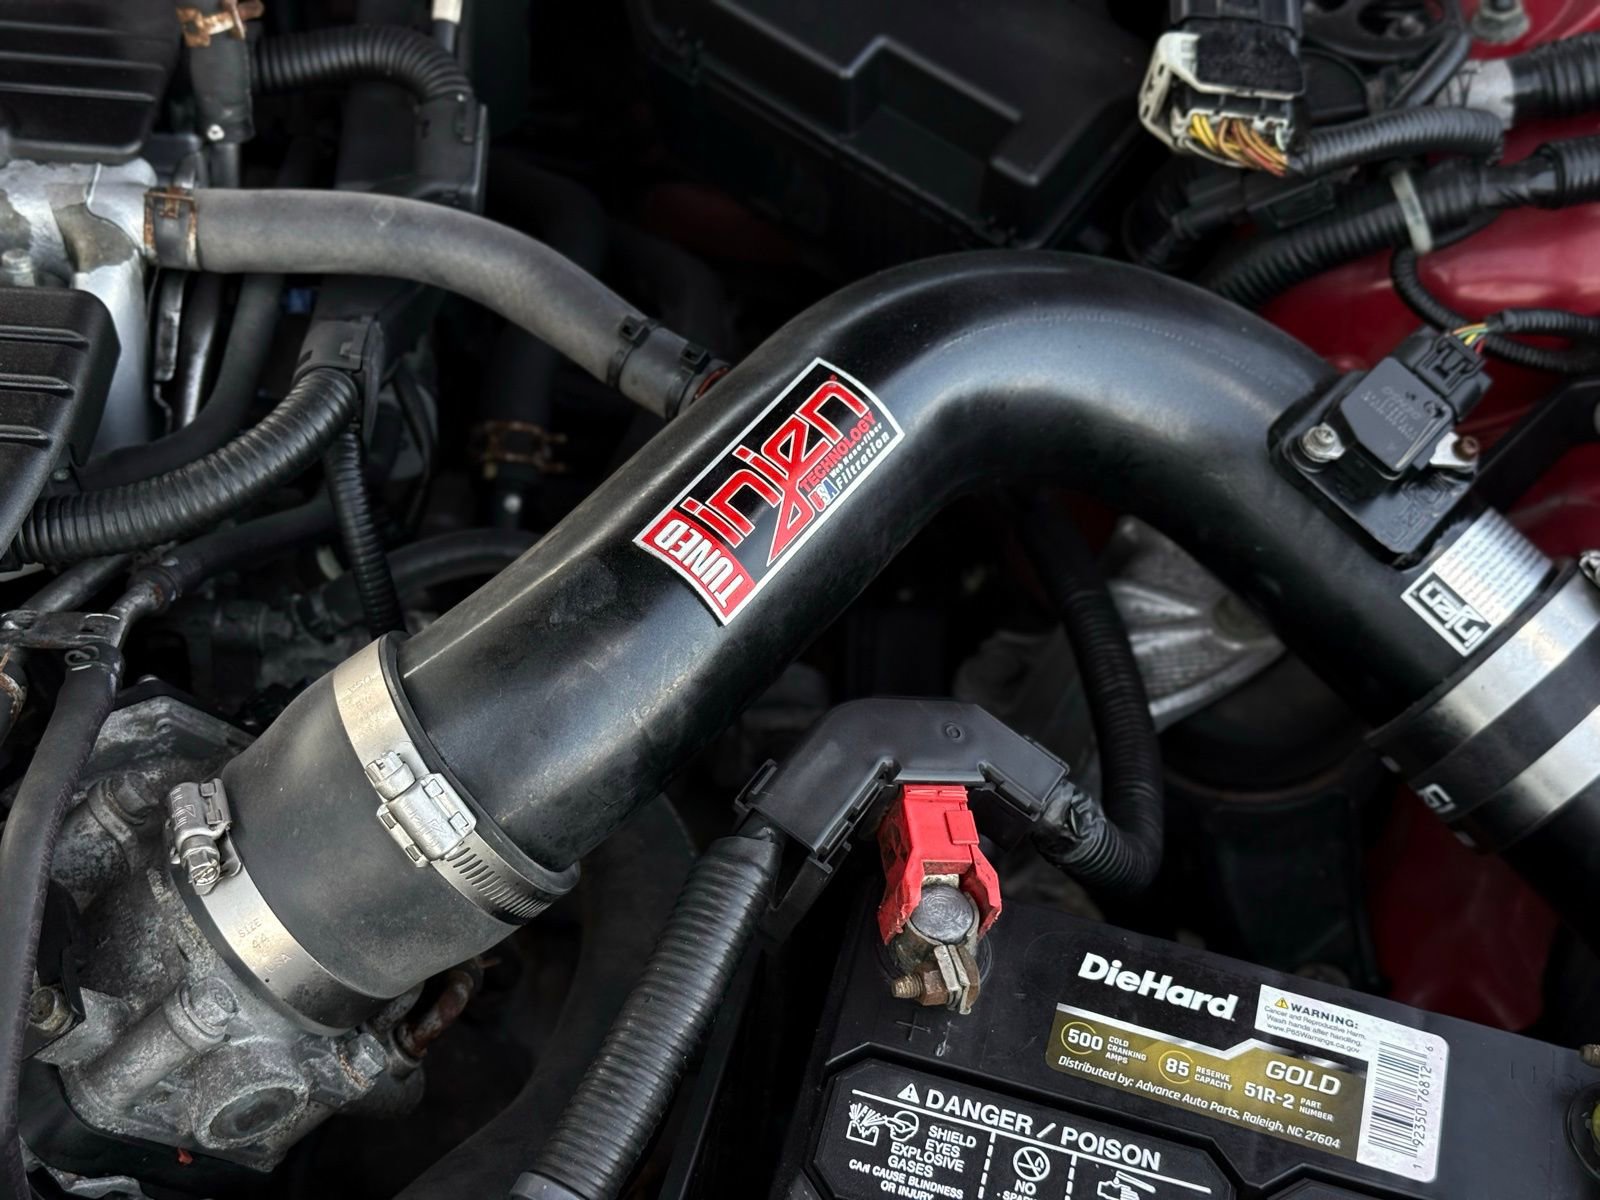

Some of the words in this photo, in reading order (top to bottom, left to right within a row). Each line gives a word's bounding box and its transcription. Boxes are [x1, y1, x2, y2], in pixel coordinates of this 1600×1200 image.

[800, 411, 876, 492] TECHNOLOGY
[836, 431, 890, 490] Filtration
[680, 381, 869, 567] injen
[808, 477, 840, 512] USA
[653, 519, 745, 609] TUNED
[1078, 952, 1239, 1020] DieHard
[1264, 1005, 1288, 1017] Cancer
[1288, 1014, 1302, 1022] and
[1303, 1017, 1346, 1034] Reproductive
[1266, 1013, 1287, 1025] Wash
[1288, 1021, 1311, 1032] hands
[1312, 1027, 1329, 1037] after
[1291, 1003, 1359, 1029] WARNING:
[1067, 1028, 1103, 1051] 500
[1108, 1035, 1129, 1047] COLD
[1266, 1023, 1360, 1054] www.P65Warnings.ca.gov
[1424, 1045, 1434, 1053] 6
[1105, 1052, 1129, 1064] AMPS
[1106, 1043, 1147, 1062] CRANKING
[1165, 1057, 1190, 1077] 85
[1195, 1065, 1231, 1082] RESERVE
[1265, 1060, 1342, 1096] GOLD
[1194, 1074, 1233, 1092] CAPACITY
[1244, 1081, 1295, 1110] 51R-2
[1417, 1064, 1432, 1103] 76812
[1058, 1055, 1116, 1082] Distributed
[1117, 1074, 1134, 1088] by:
[1135, 1079, 1182, 1101] Advance
[1182, 1093, 1208, 1109] Auto
[1209, 1101, 1241, 1120] Parts,
[1242, 1111, 1284, 1133] Raleigh,
[1286, 1124, 1304, 1138] NC
[1304, 1130, 1341, 1149] 27604
[1299, 1106, 1335, 1122] NUMBER
[1300, 1097, 1322, 1110] PART
[925, 1088, 1033, 1136] DANGER
[1060, 1126, 1161, 1171] POISON
[928, 1125, 977, 1149] SHIELD
[1412, 1107, 1428, 1147] 92350
[890, 1141, 966, 1173] EXPLOSIVE
[925, 1138, 961, 1158] EYES
[848, 1159, 871, 1174] CAN
[872, 1165, 907, 1184] CAUSE
[907, 1175, 964, 1200] BLINDNESS
[887, 1155, 934, 1178] GASES
[880, 1180, 897, 1193] OR
[897, 1185, 934, 1200] INJURY
[1014, 1179, 1037, 1196] NO
